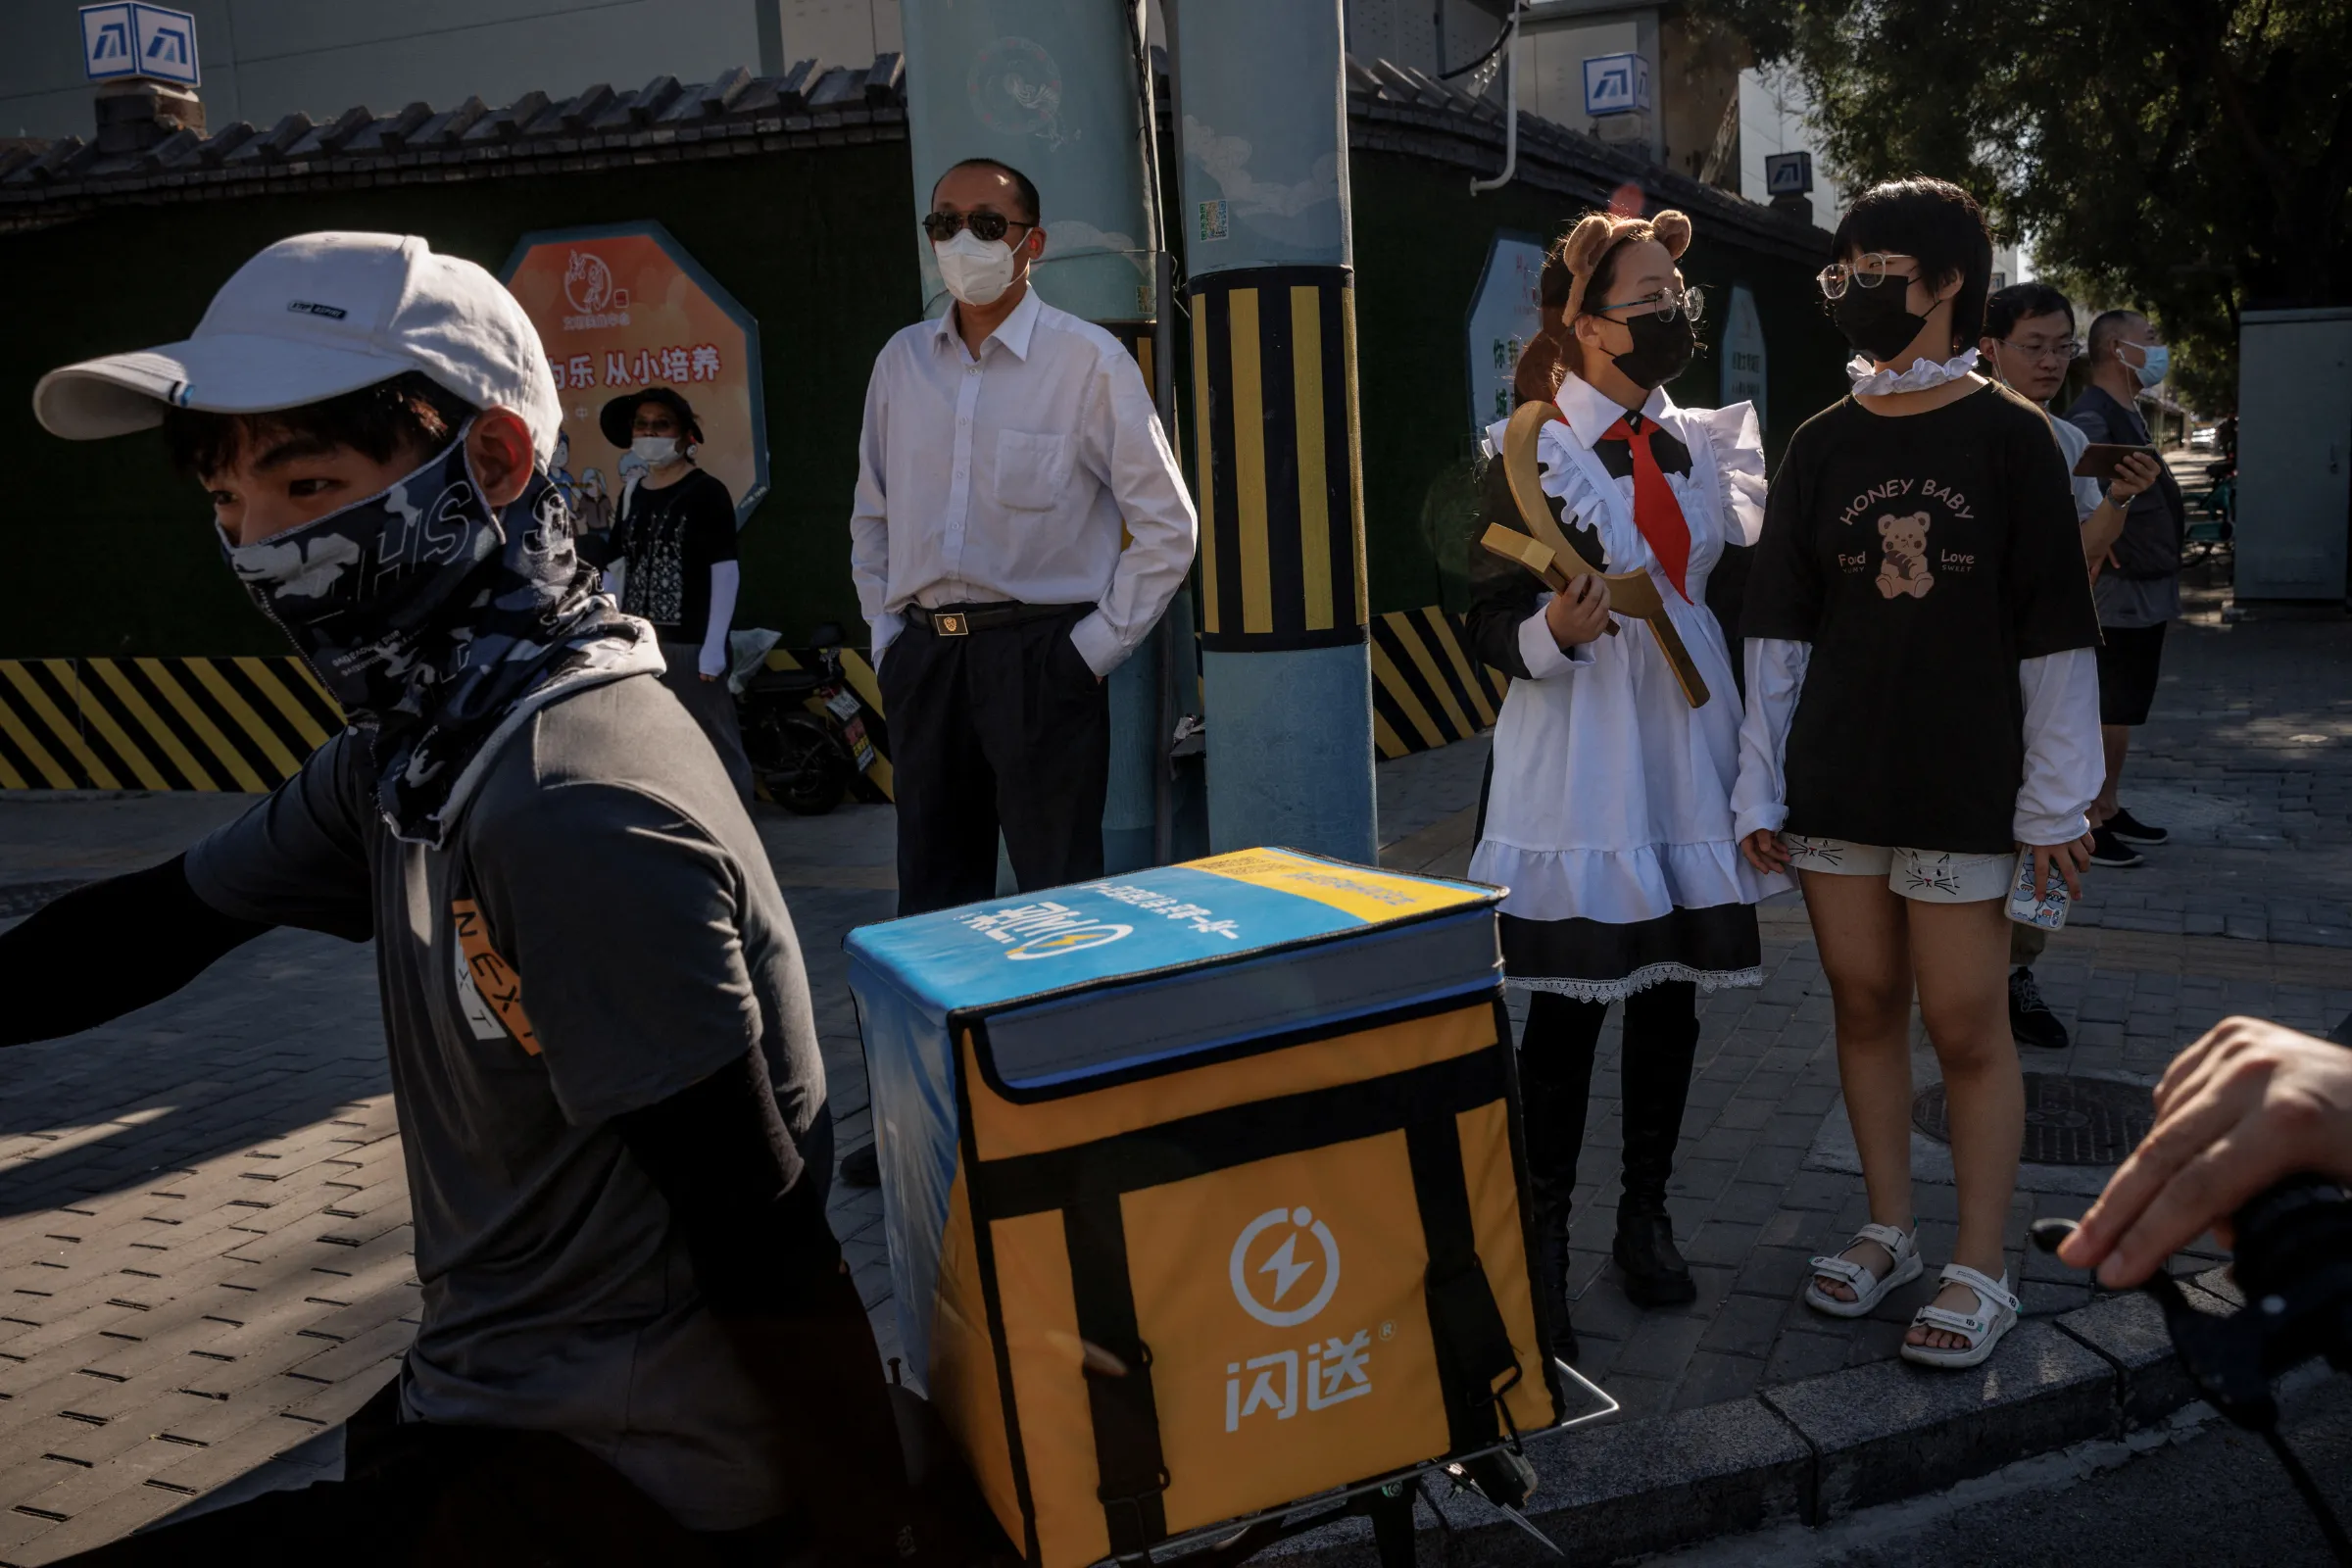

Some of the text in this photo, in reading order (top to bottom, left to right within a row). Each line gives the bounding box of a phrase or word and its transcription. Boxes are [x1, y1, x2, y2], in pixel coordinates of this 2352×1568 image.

[604, 344, 721, 387] 从小培养
[1839, 478, 1975, 526] HONEY BABY
[1940, 548, 1975, 564] Love
[1941, 564, 1972, 572] SWEET
[1226, 1329, 1372, 1433] 闪送
